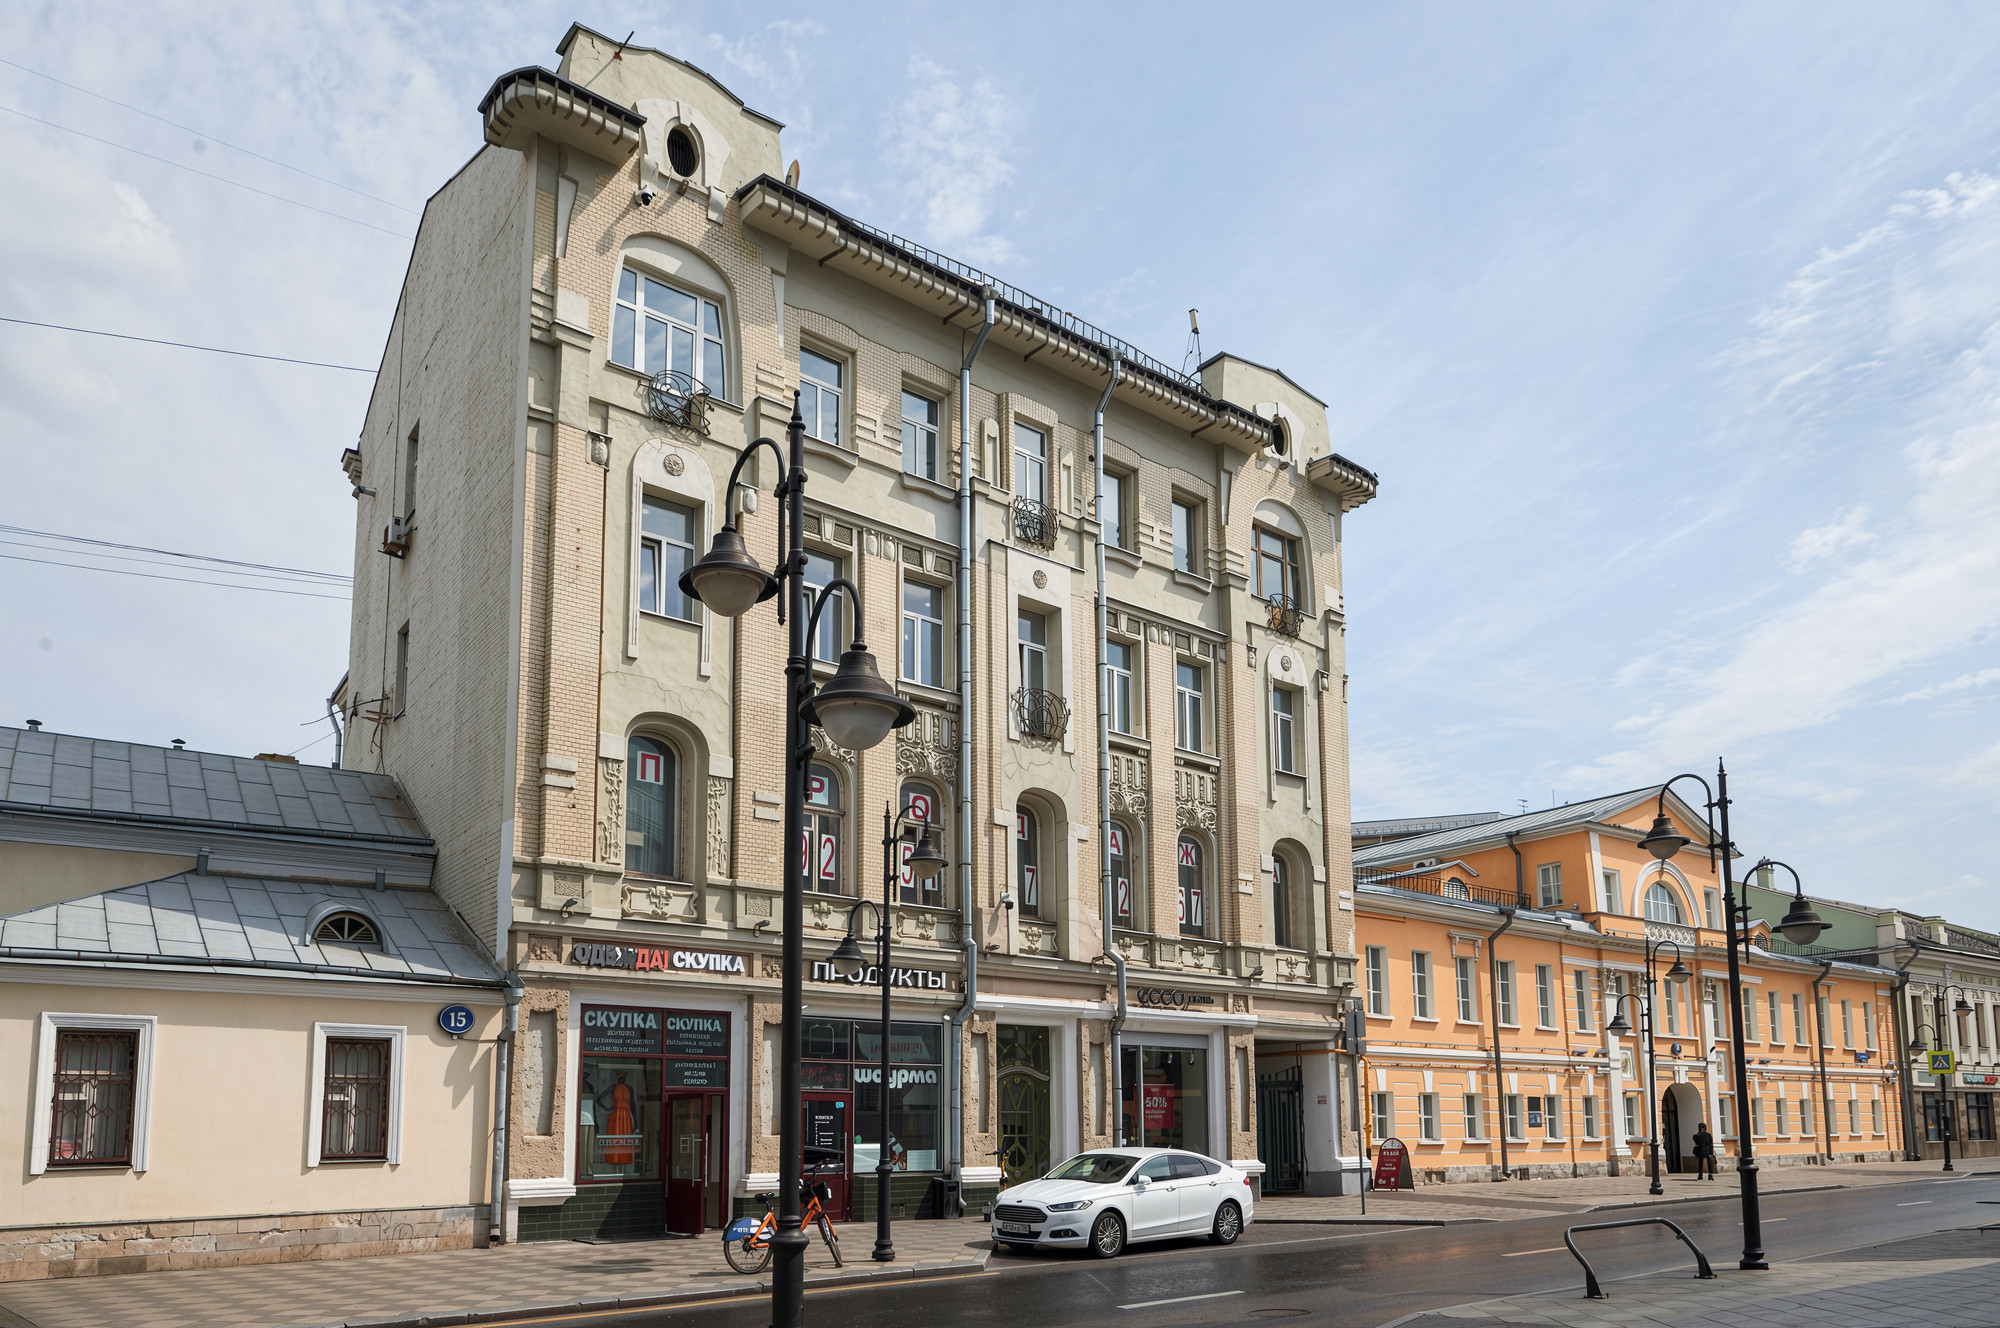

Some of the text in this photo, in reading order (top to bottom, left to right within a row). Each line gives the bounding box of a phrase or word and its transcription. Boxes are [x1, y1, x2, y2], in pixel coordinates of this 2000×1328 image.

[641, 752, 660, 782] П
[809, 776, 825, 801] Р
[1110, 831, 1121, 853] А
[1180, 844, 1195, 865] Ж
[1026, 867, 1036, 903] 7
[1120, 880, 1128, 914] 2
[673, 951, 746, 973] СКУПКА
[450, 1012, 466, 1027] 15
[584, 1010, 657, 1029] СКУПКА
[667, 1017, 722, 1032] СКУПКА
